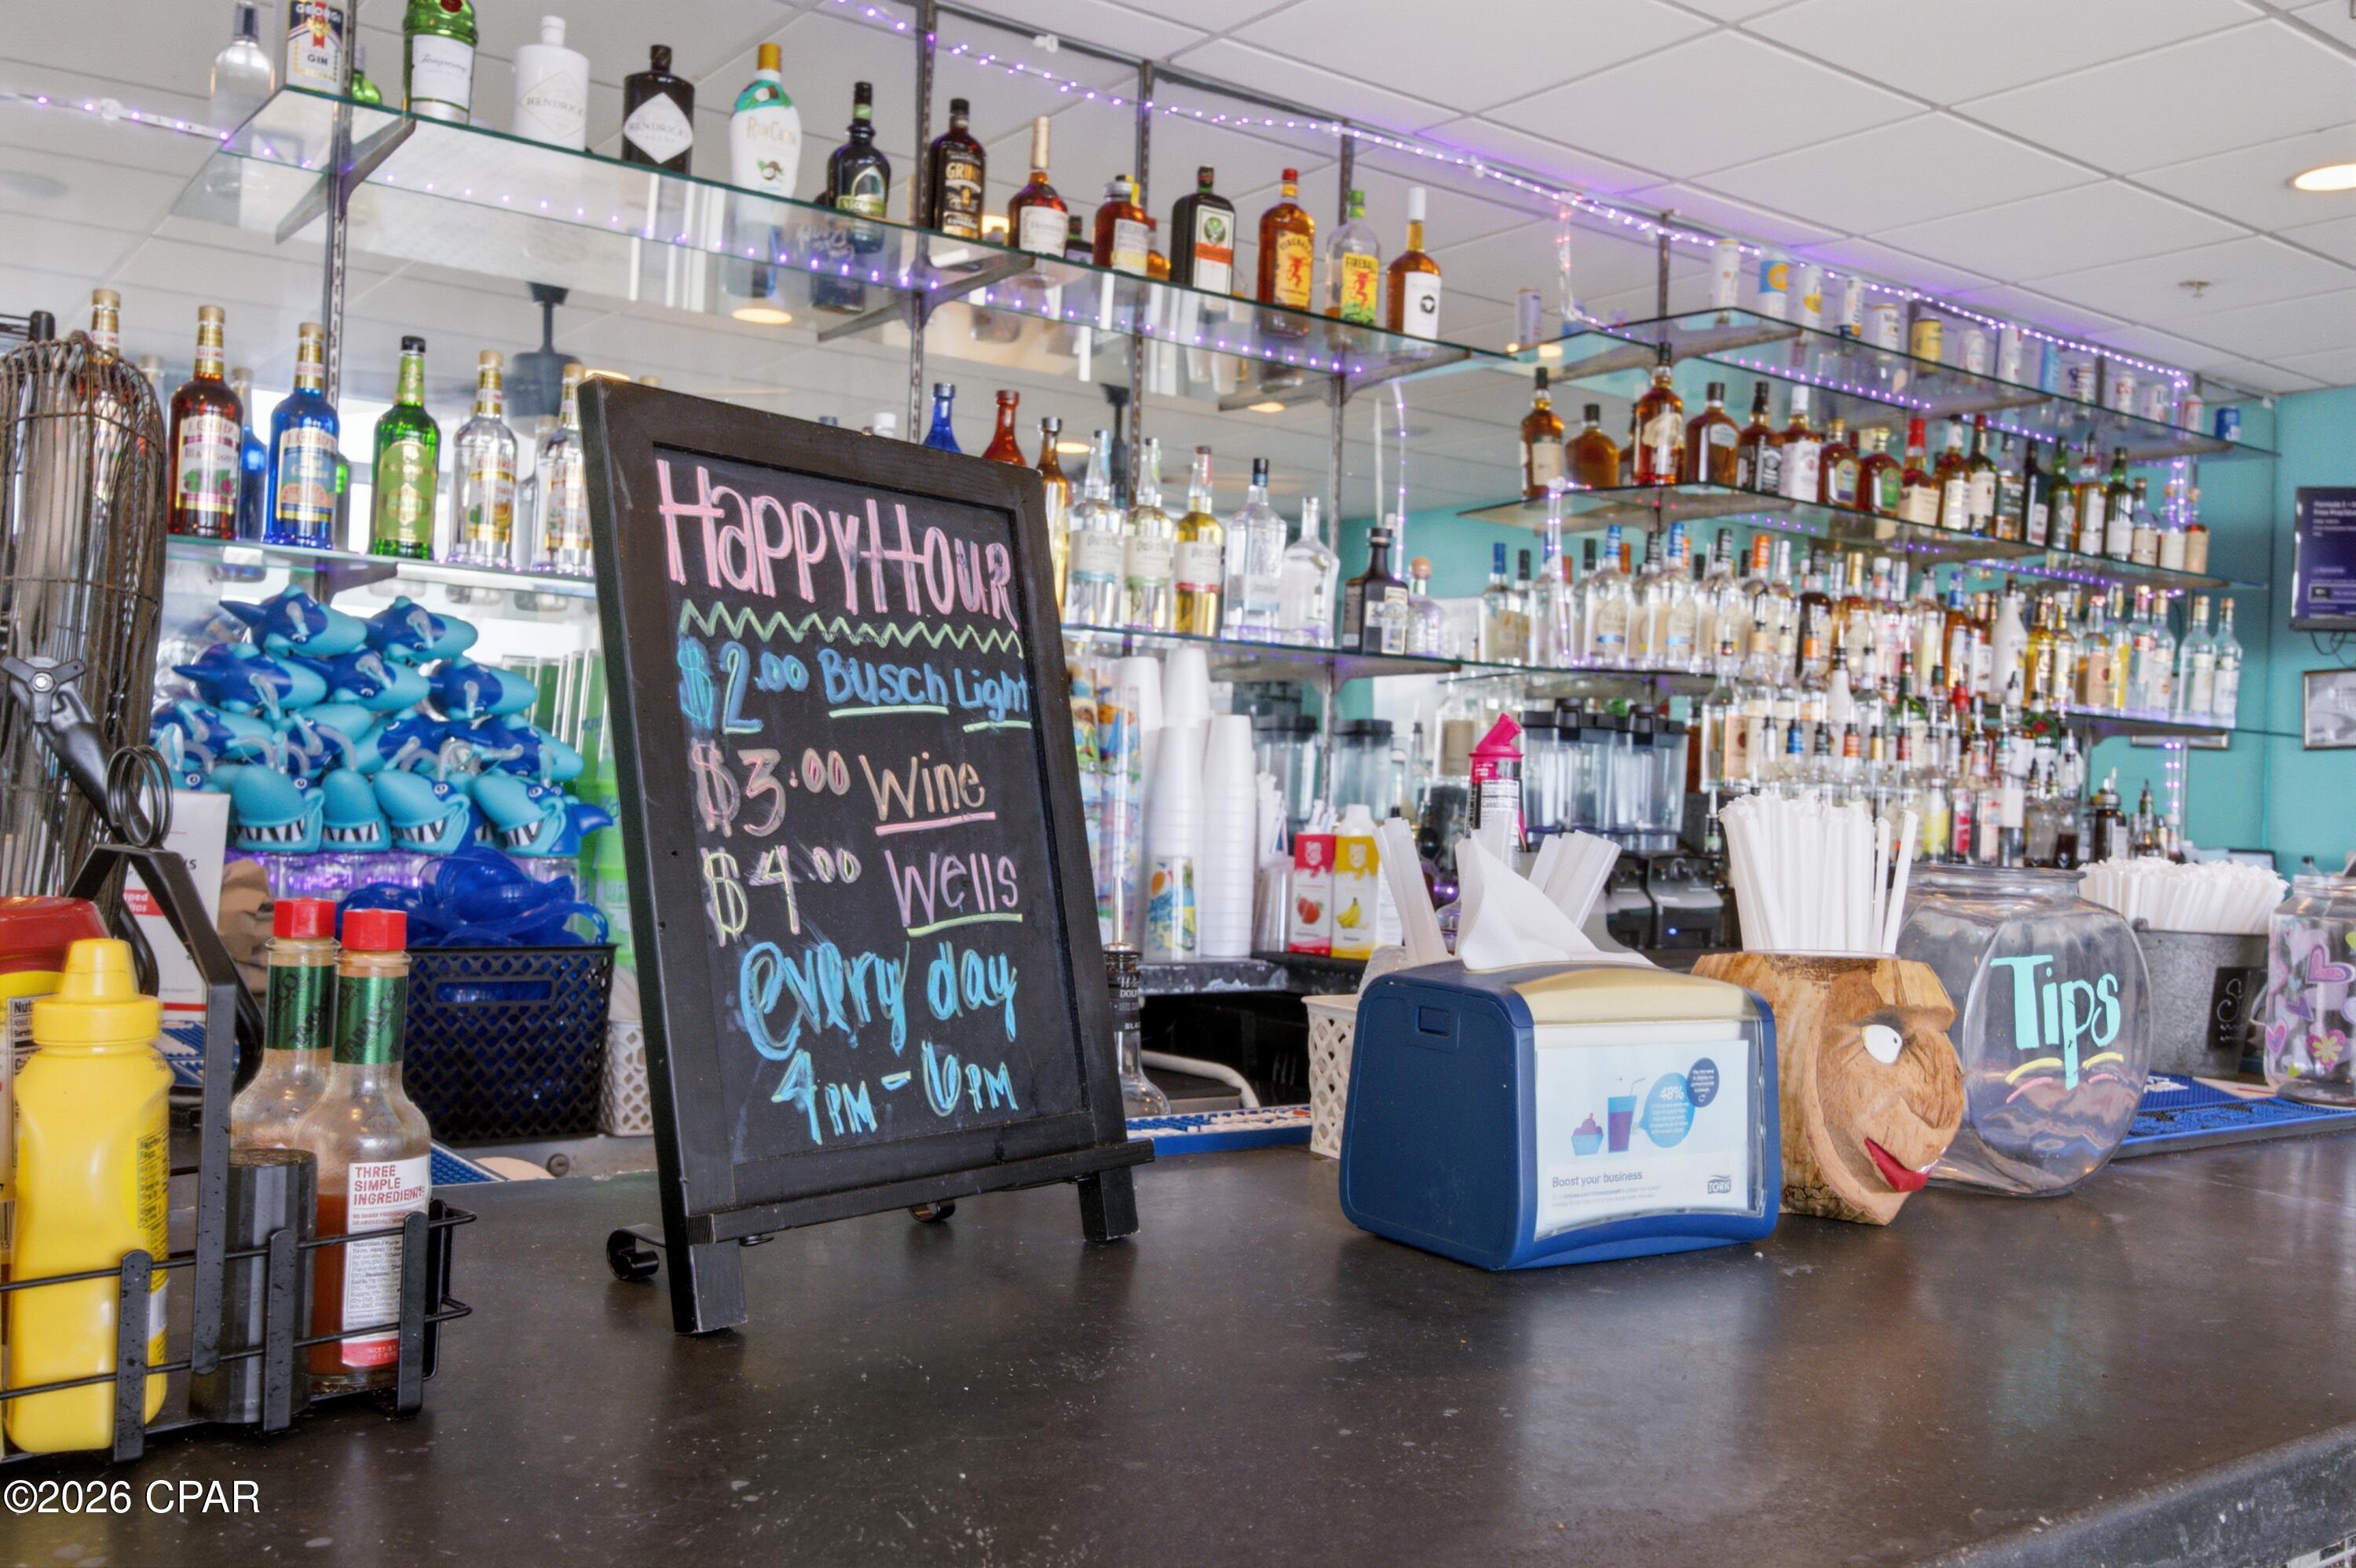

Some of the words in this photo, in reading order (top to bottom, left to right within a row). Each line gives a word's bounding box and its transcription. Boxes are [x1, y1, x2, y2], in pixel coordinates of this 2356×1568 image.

[307, 53, 328, 66] GIN
[676, 634, 809, 735] $2.00
[818, 648, 949, 706] Busch
[953, 666, 1030, 721] Light
[688, 736, 851, 838] $3.00
[858, 751, 986, 821] Wine
[700, 844, 862, 947] $4.00
[884, 849, 1019, 928] Wells
[927, 941, 1018, 1043] day
[1989, 954, 2120, 1091] Tips
[354, 1177, 401, 1192] SIMPLE
[355, 1164, 396, 1179] THREE
[1552, 1176, 1579, 1188] Boost
[1581, 1175, 1601, 1186] your
[1603, 1171, 1643, 1182] business
[1708, 1179, 1732, 1193] TORK
